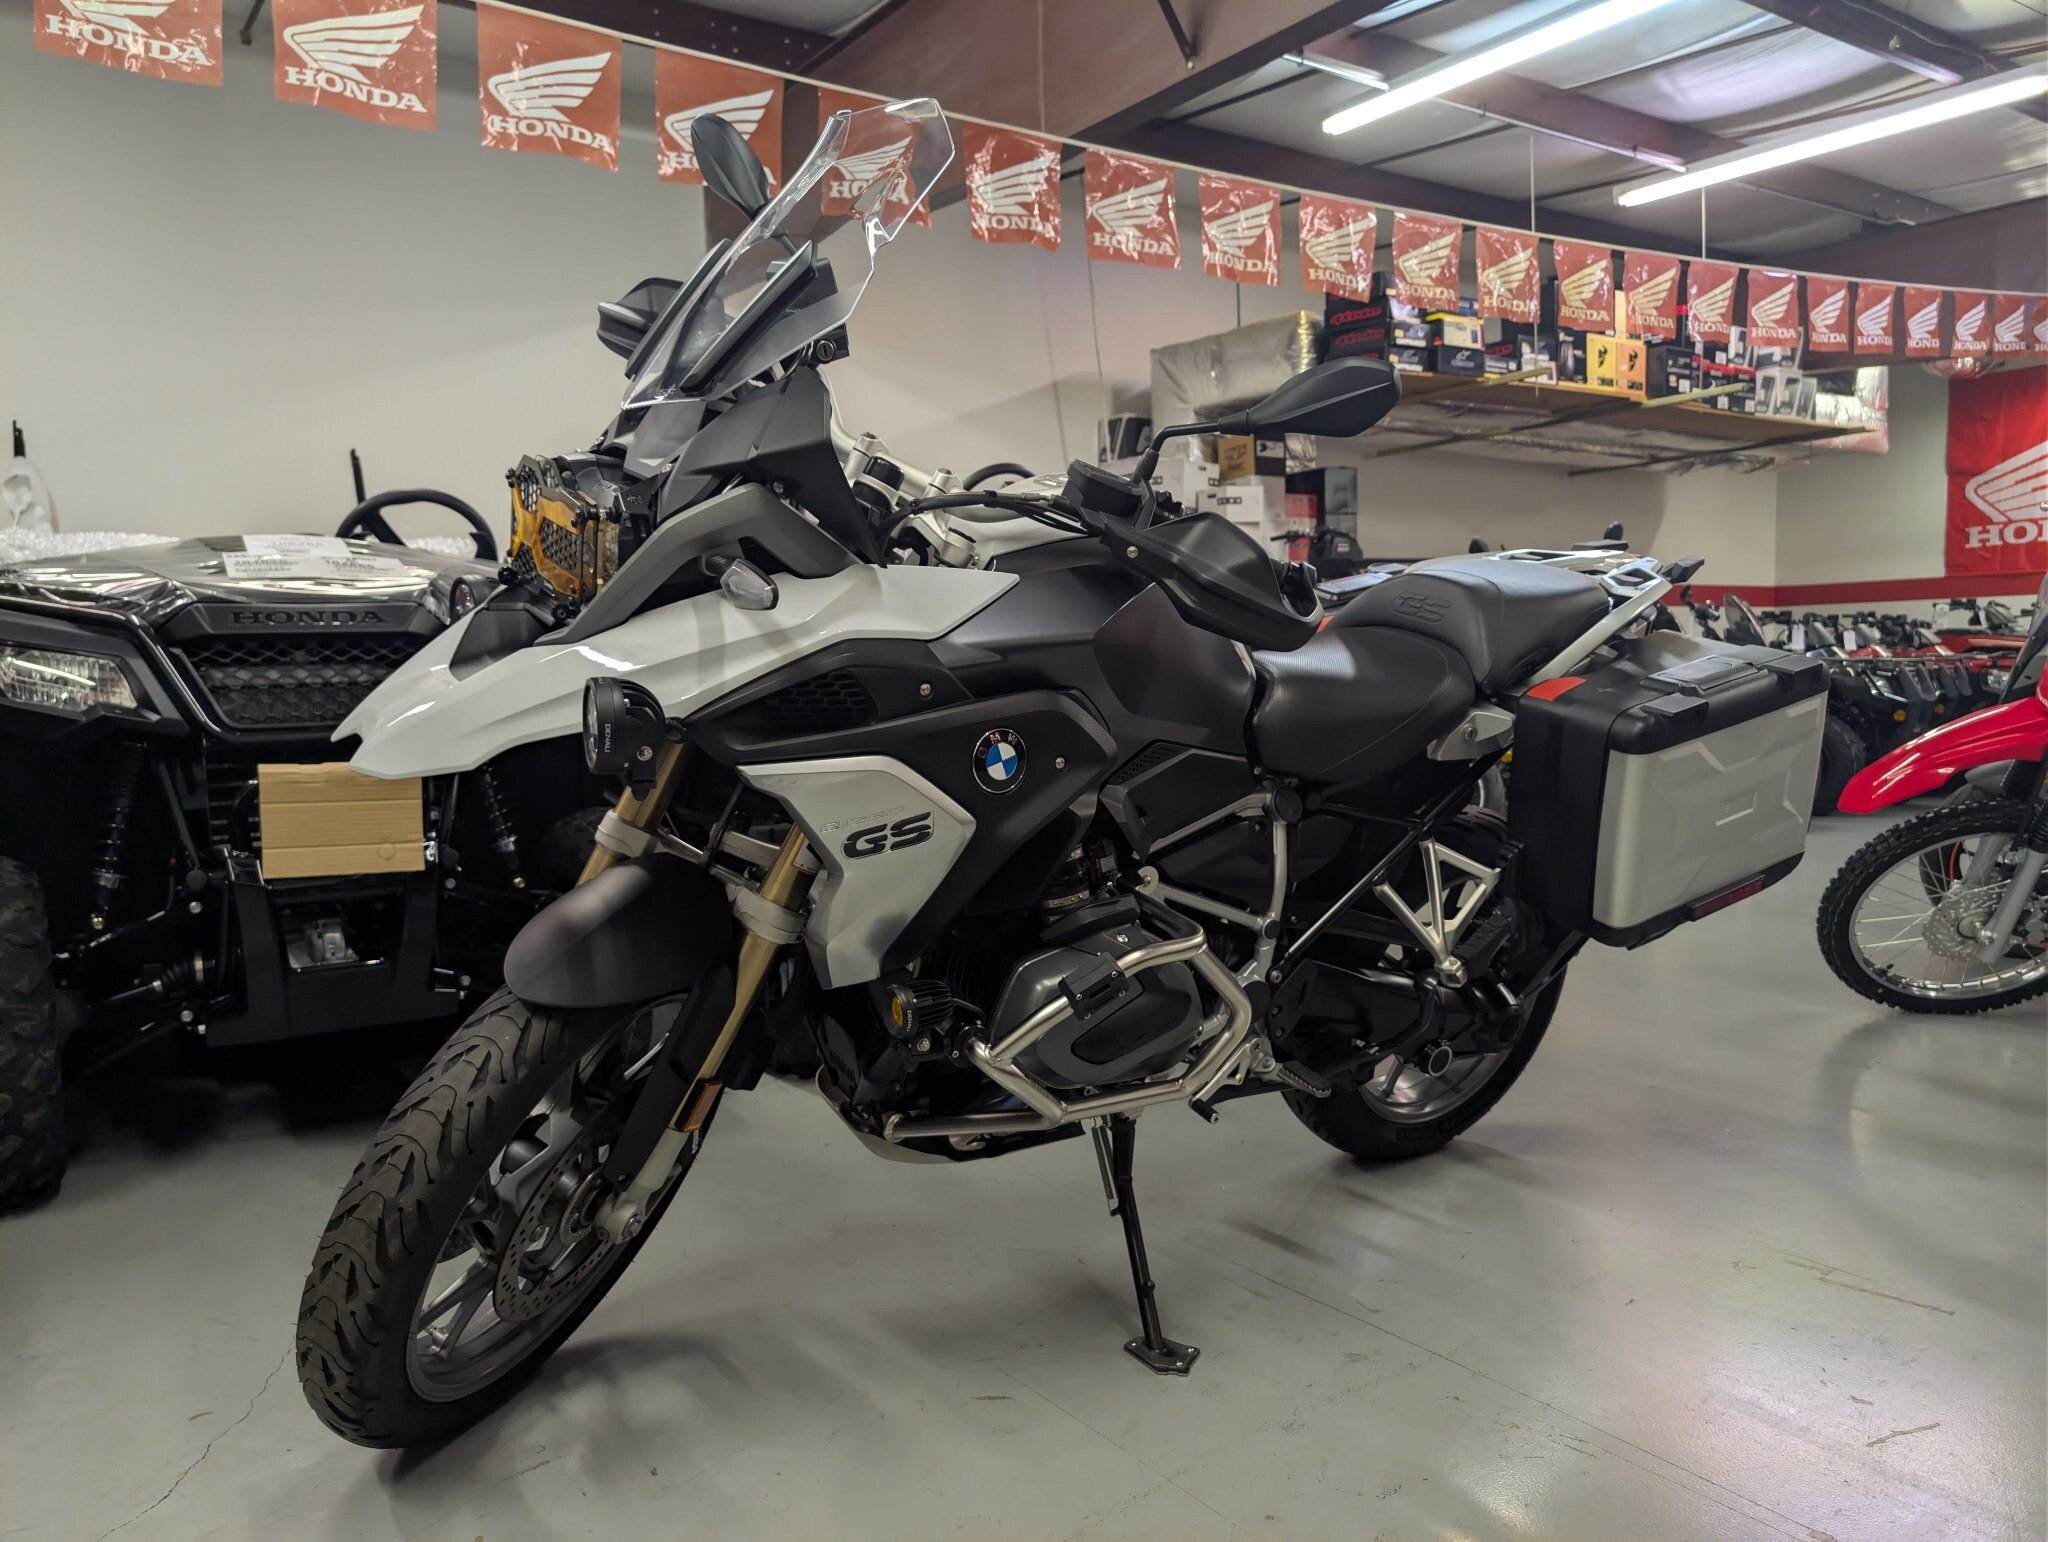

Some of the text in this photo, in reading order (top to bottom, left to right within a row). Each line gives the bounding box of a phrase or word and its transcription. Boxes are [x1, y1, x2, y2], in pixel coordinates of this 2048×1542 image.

[45, 14, 214, 67] HONDA
[285, 66, 428, 114] HONDA
[491, 116, 614, 154] HONDA
[974, 213, 1056, 238] HONDA
[1093, 232, 1175, 257] HONDA
[1207, 252, 1278, 274] HONDA
[1560, 305, 1610, 322] HONDA
[1631, 315, 1675, 329] HONDA
[1750, 326, 1797, 339] HONDA
[230, 611, 387, 625] HONDA
[977, 731, 1019, 759] BMW
[842, 811, 933, 859] GS
